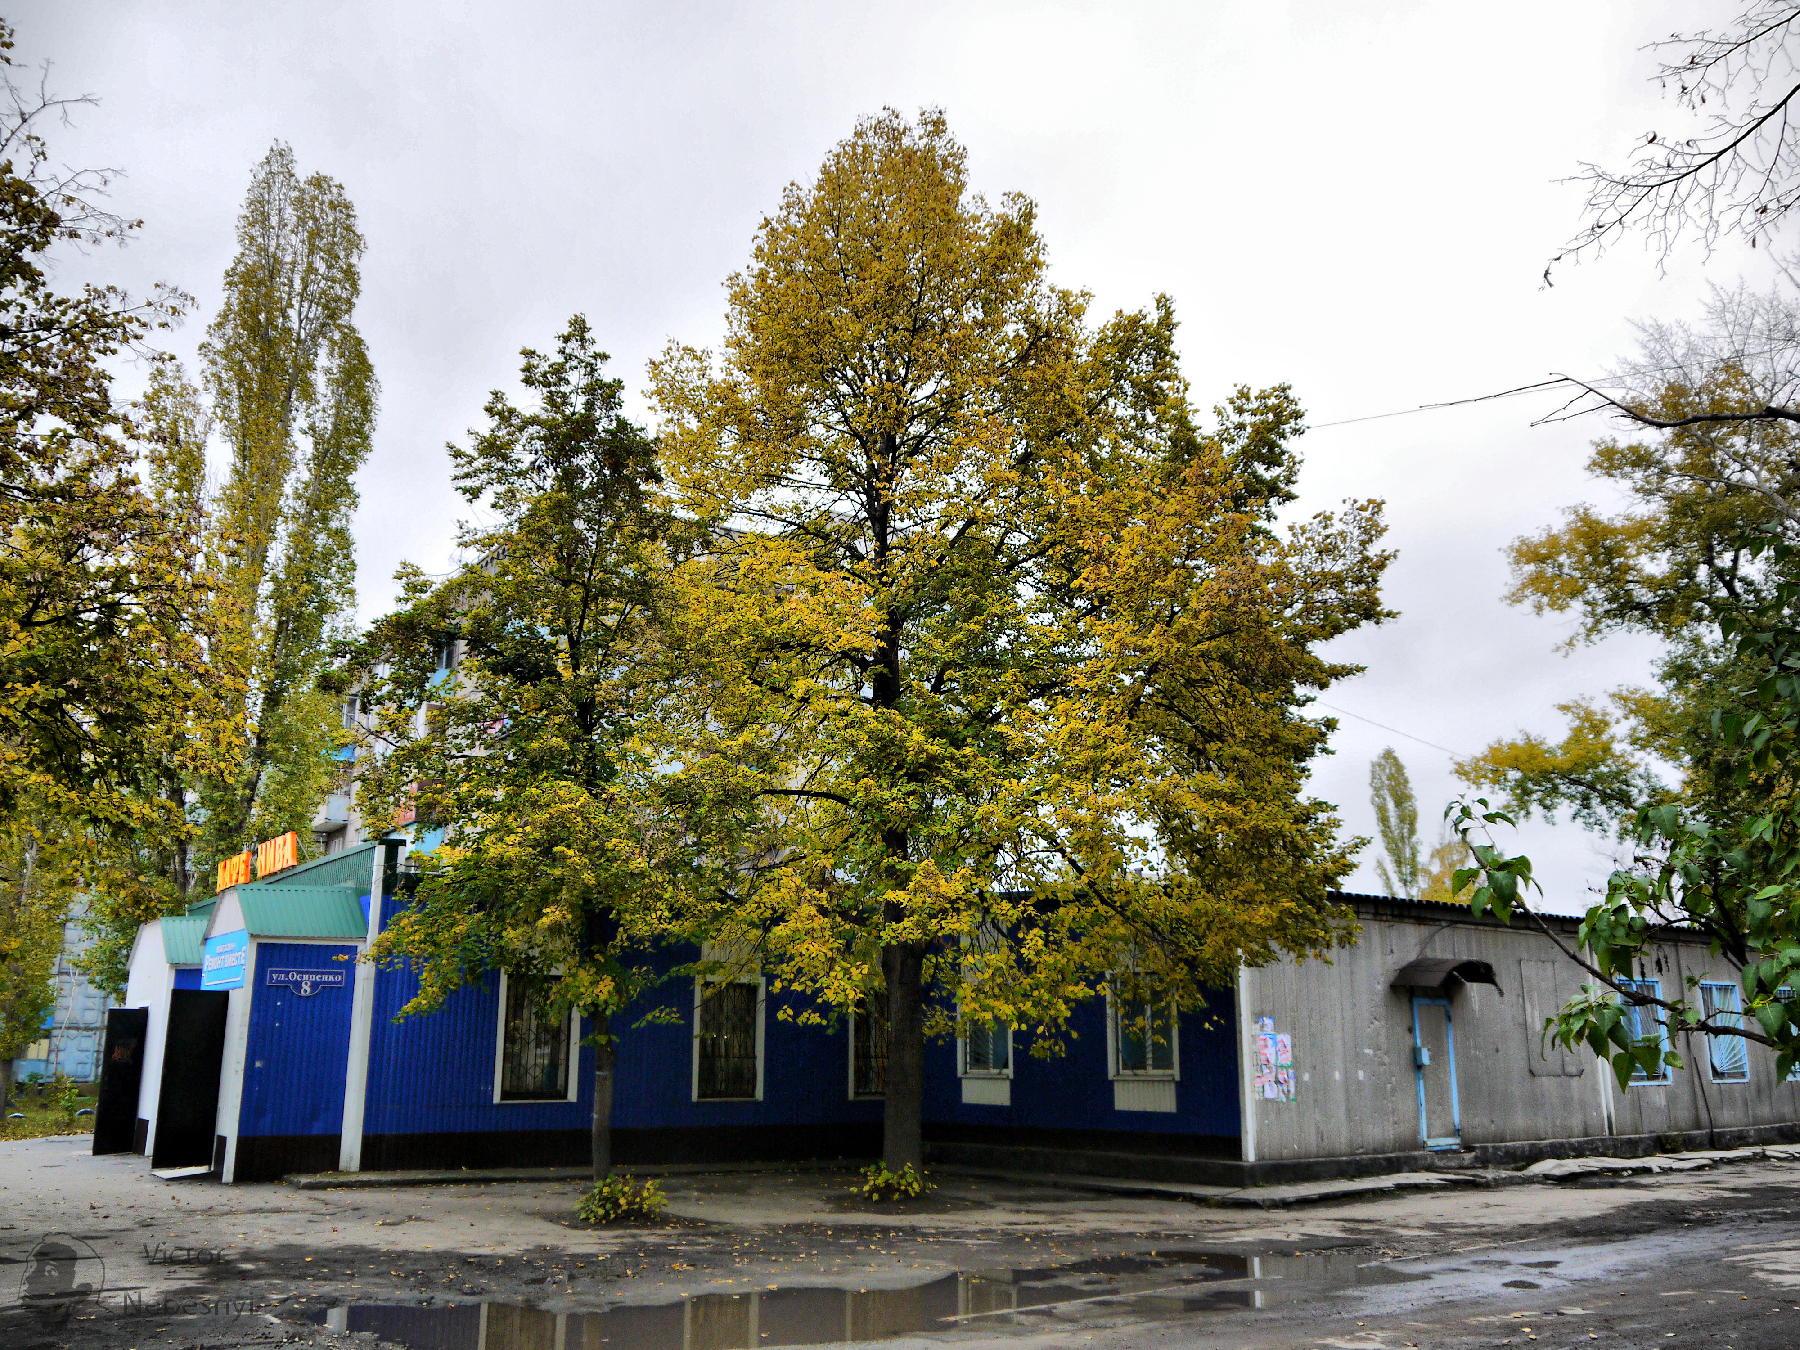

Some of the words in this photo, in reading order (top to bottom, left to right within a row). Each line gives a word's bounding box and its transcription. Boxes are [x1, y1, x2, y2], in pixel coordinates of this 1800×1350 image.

[216, 851, 251, 893] КАФЕ
[257, 831, 297, 877] НИВА
[300, 980, 311, 995] 8
